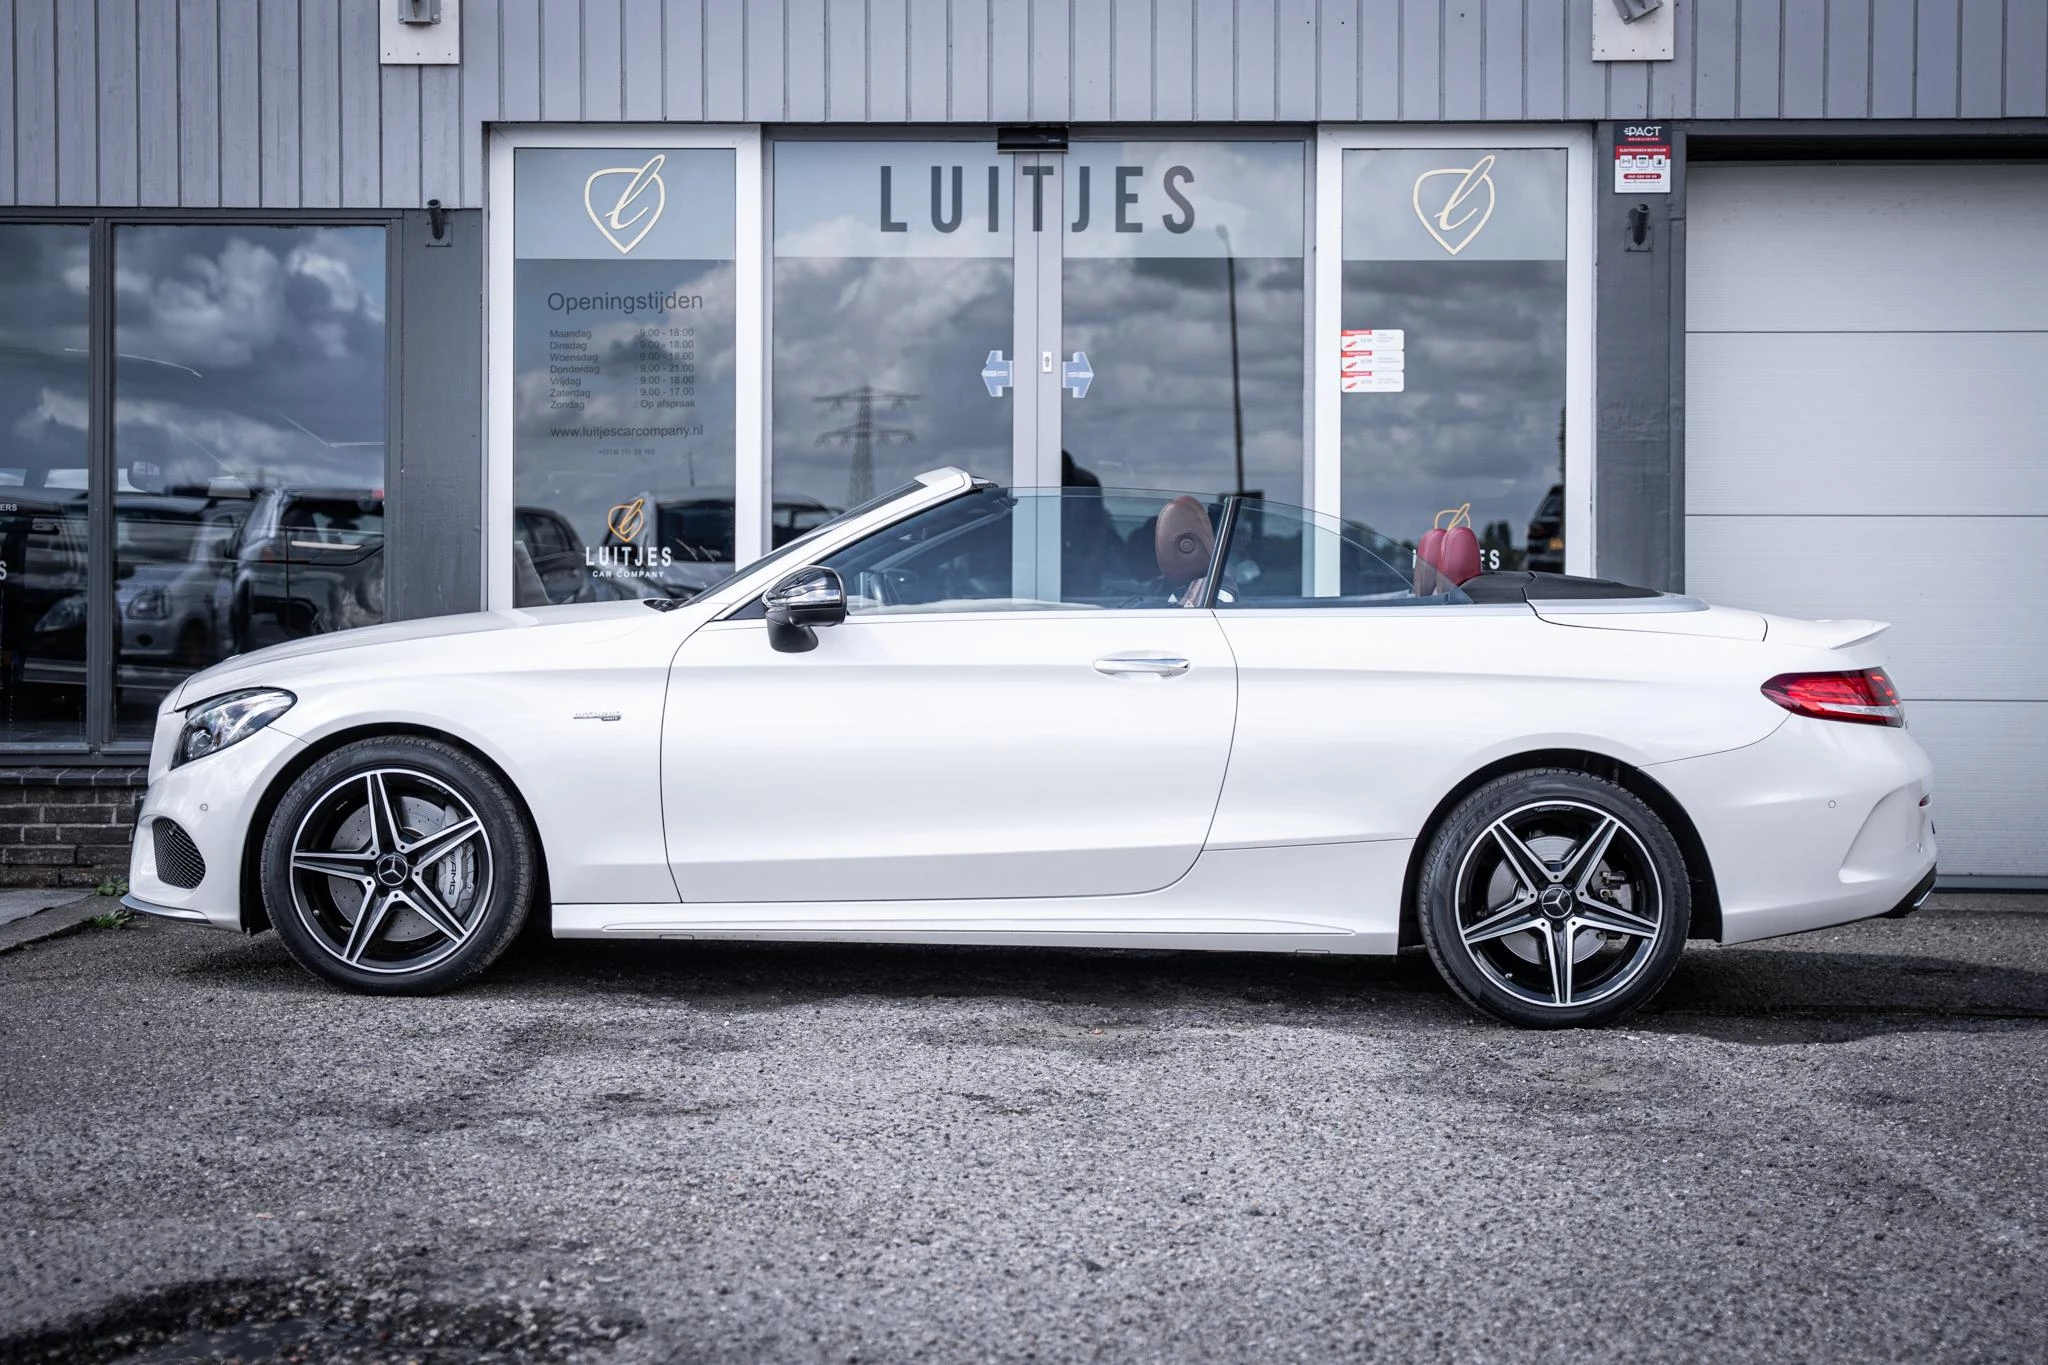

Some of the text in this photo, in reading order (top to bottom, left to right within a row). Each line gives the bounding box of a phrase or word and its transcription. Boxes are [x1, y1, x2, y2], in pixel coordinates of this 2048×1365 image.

[880, 165, 1195, 234] LUITJES
[547, 291, 703, 314] Openingstijden
[549, 329, 592, 340] Maandag
[550, 341, 587, 351] Dinsdag
[550, 352, 599, 363] Woensdag
[550, 364, 600, 375] Donderdag
[550, 376, 582, 387] Vrijdag
[550, 388, 591, 399] Zaterdag
[550, 400, 585, 410] Zondag
[640, 400, 654, 410] Op
[656, 399, 696, 409] afspraak
[550, 424, 704, 439] www.luitjescarcompany.nl
[585, 546, 672, 567] LUITJES
[592, 570, 665, 578] CAR COMPANY
